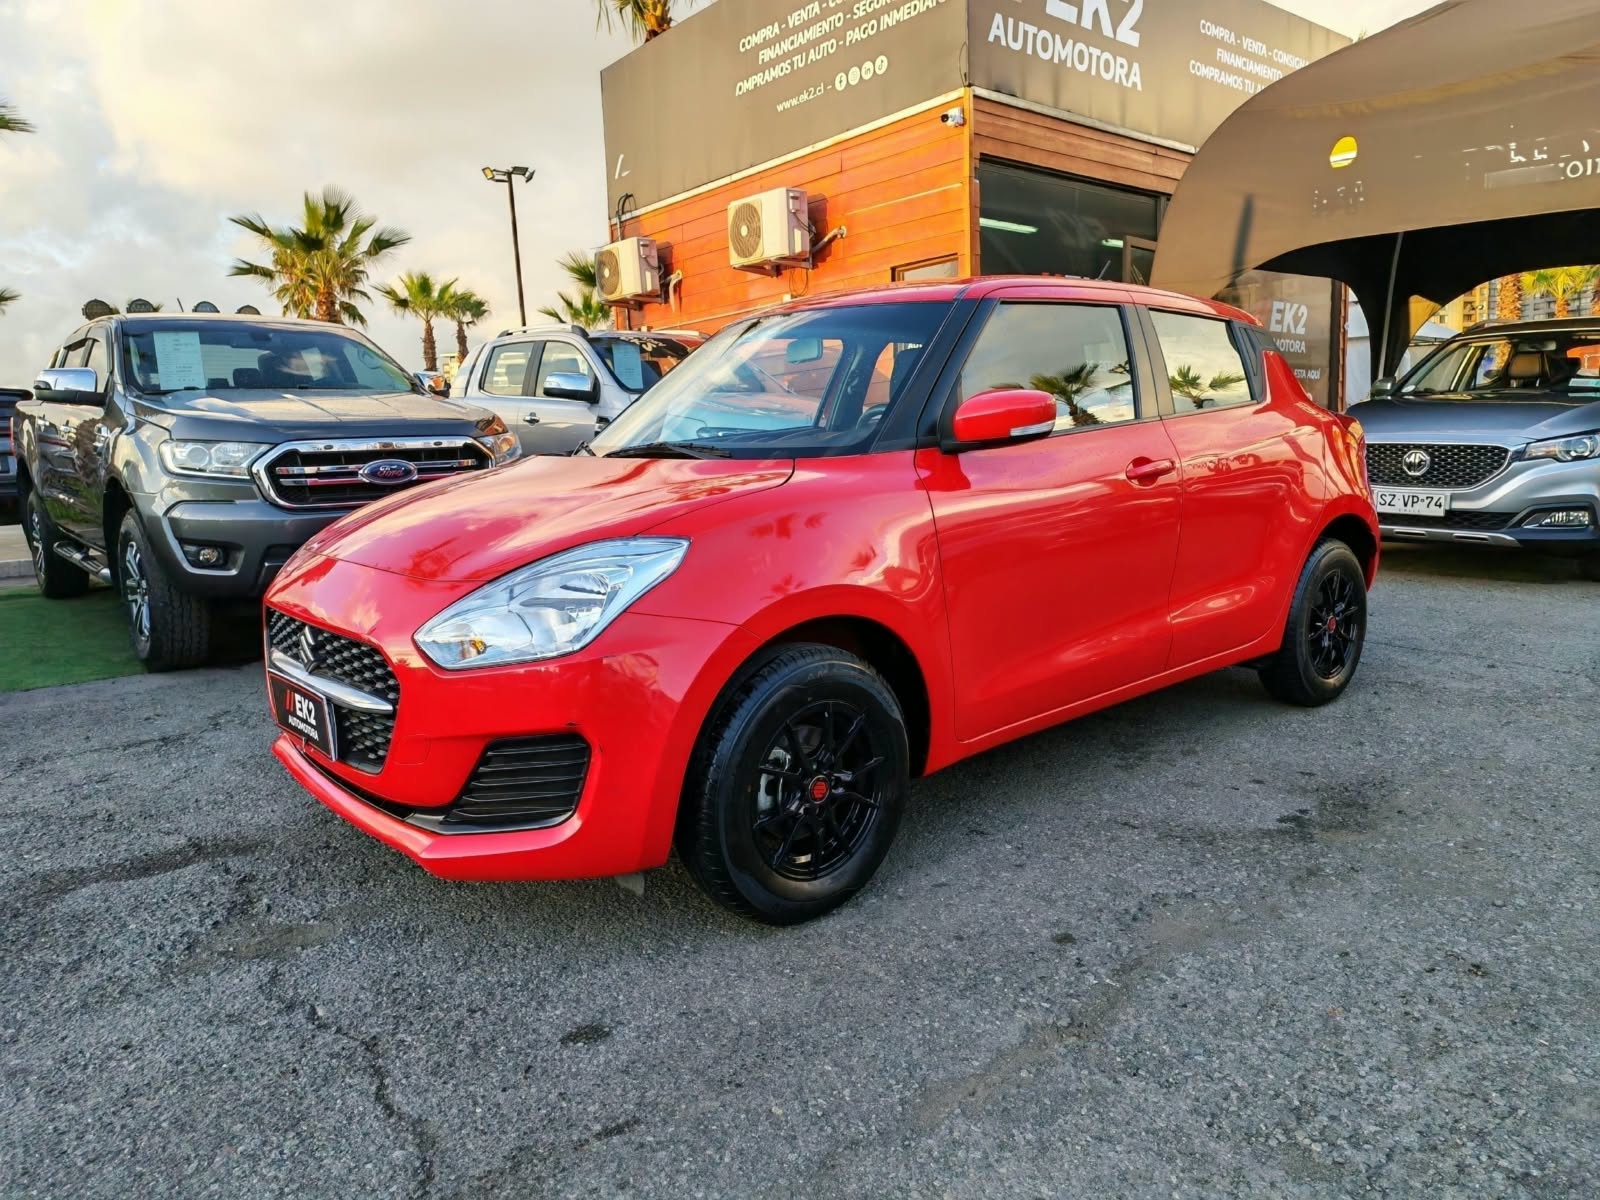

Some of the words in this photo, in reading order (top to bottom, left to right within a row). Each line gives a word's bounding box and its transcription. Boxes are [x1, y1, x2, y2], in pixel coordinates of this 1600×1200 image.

[739, 22, 780, 52] COMPRA
[787, 1, 820, 29] VENTA
[758, 12, 844, 65] FINANCIAMIENTO
[1200, 19, 1236, 46] COMPRA
[1242, 35, 1267, 58] VENTA
[735, 59, 791, 97] OMPRAMOS
[792, 53, 806, 70] TU
[808, 38, 837, 64] AUTO
[845, 19, 878, 46] PAGO
[880, 0, 946, 31] INMEDIA
[987, 12, 1143, 91] AUTOMOTORA
[1216, 48, 1283, 81] FINANCIAMIENTO
[1189, 60, 1243, 90] COMPRAMOS
[1244, 79, 1255, 94] TU
[776, 83, 824, 112] www.ek2.cl
[1269, 301, 1308, 335] EK2
[294, 692, 317, 726] EK2
[288, 714, 319, 741] AUTOMOTORA
